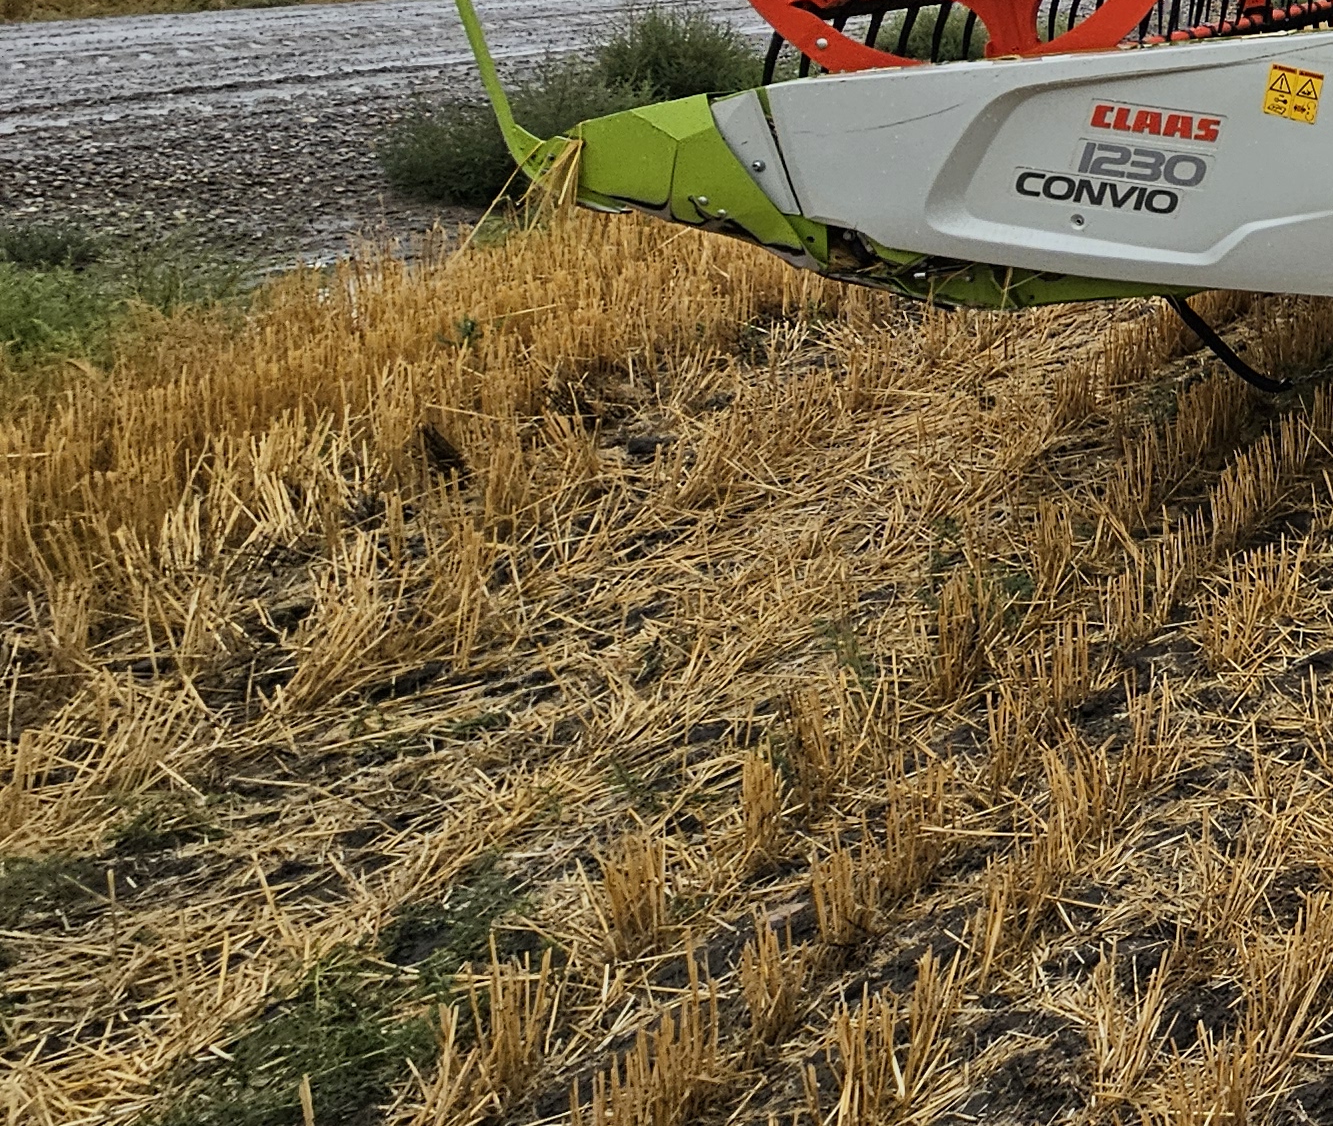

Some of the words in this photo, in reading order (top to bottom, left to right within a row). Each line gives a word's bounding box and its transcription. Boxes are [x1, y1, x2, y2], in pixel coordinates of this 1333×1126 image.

[1090, 104, 1221, 143] CLAAS
[1078, 142, 1207, 187] 1230
[1015, 171, 1179, 214] CONVIO
